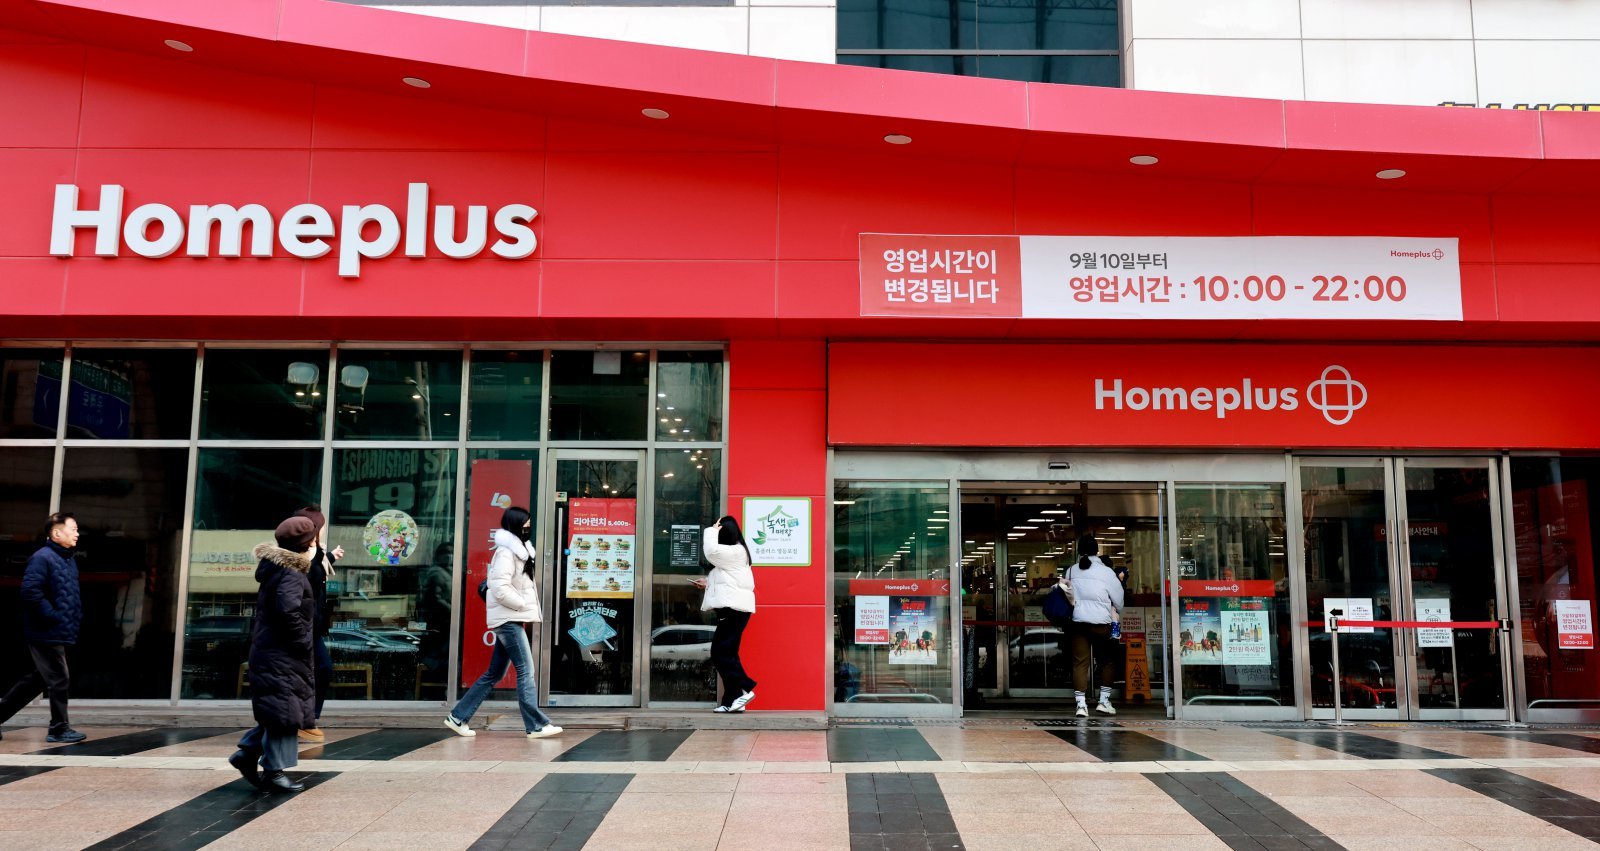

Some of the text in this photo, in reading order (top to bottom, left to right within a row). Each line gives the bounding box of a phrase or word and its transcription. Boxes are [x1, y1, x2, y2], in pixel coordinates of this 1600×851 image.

[49, 182, 538, 277] Homeplus
[883, 248, 998, 275] 영업시간이
[1069, 252, 1168, 271] 9월 10일부터
[1390, 250, 1431, 259] Homeplus
[884, 278, 1000, 304] 변경됩니다
[1069, 275, 1173, 303] 영업시간
[1193, 275, 1286, 301] 10:00
[1311, 275, 1407, 302] 22:00
[1094, 378, 1299, 419] Homeplus
[573, 517, 607, 527] 리아런치
[766, 513, 786, 534] 녹색
[775, 529, 793, 537] 매장
